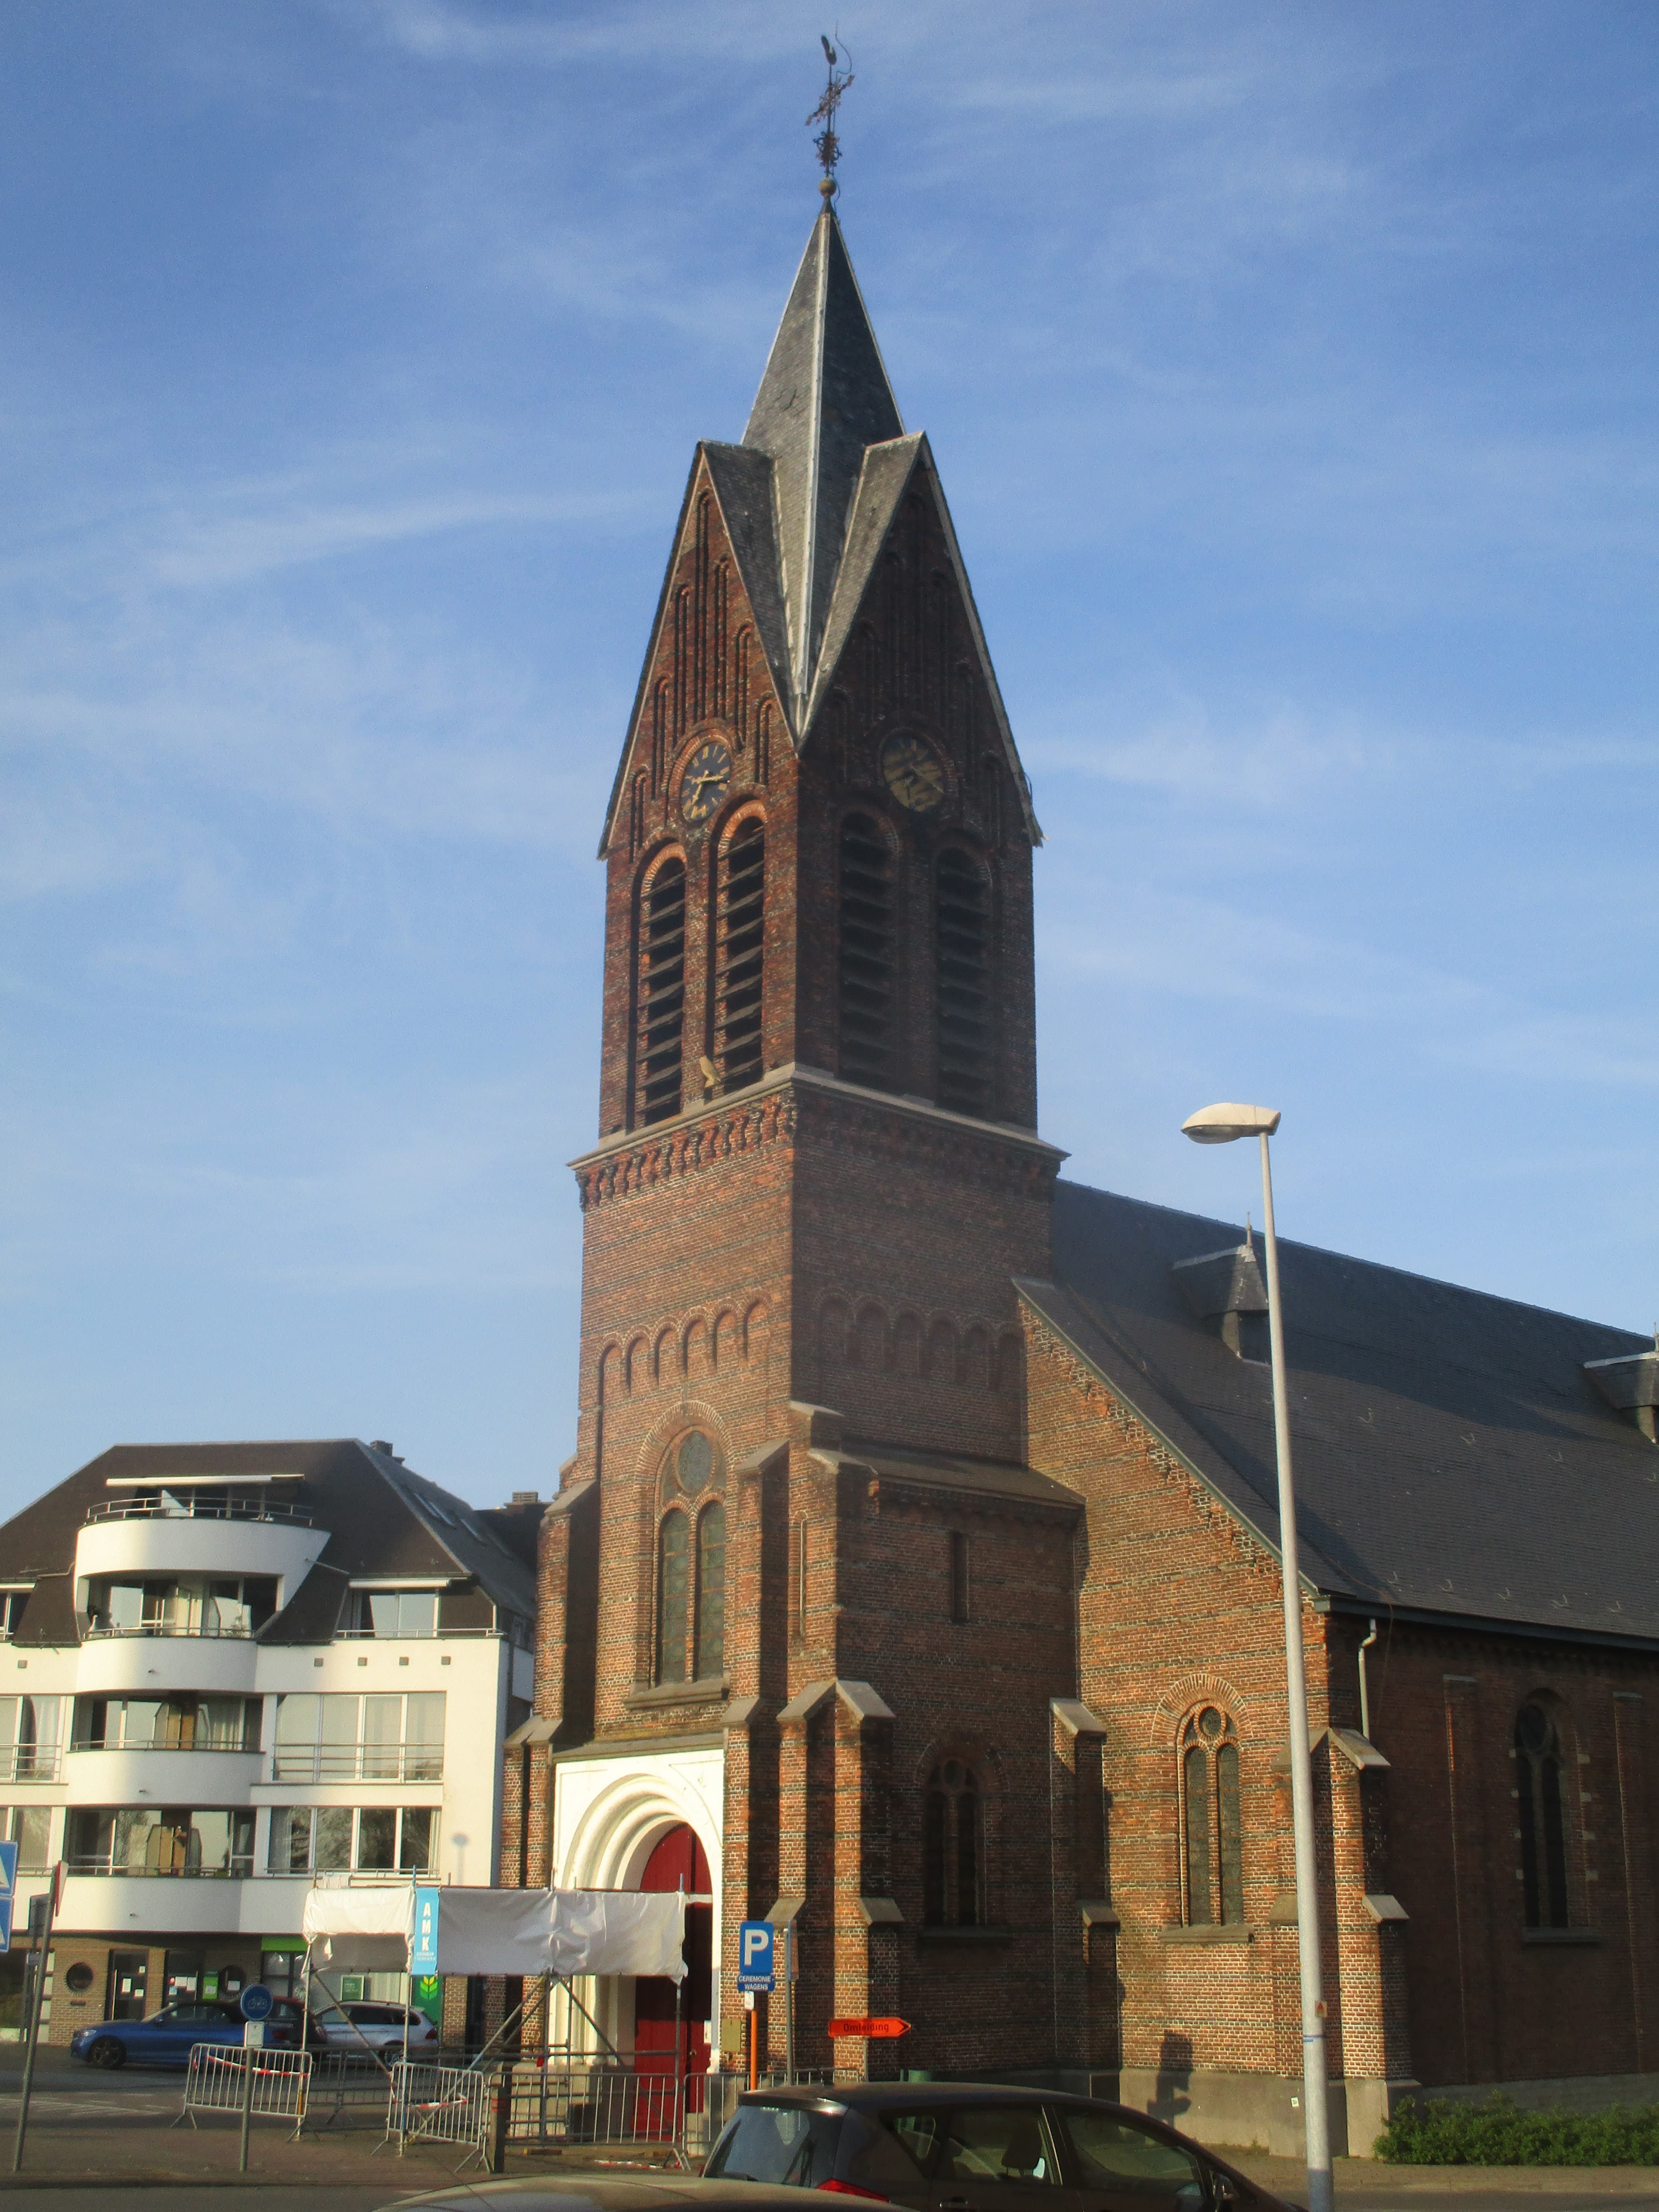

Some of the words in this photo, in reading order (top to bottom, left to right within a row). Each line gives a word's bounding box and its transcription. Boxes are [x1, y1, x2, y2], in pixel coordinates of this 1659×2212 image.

[421, 1902, 431, 1952] AMK
[744, 1929, 769, 1966] P
[843, 2023, 889, 2033] Omleiding
